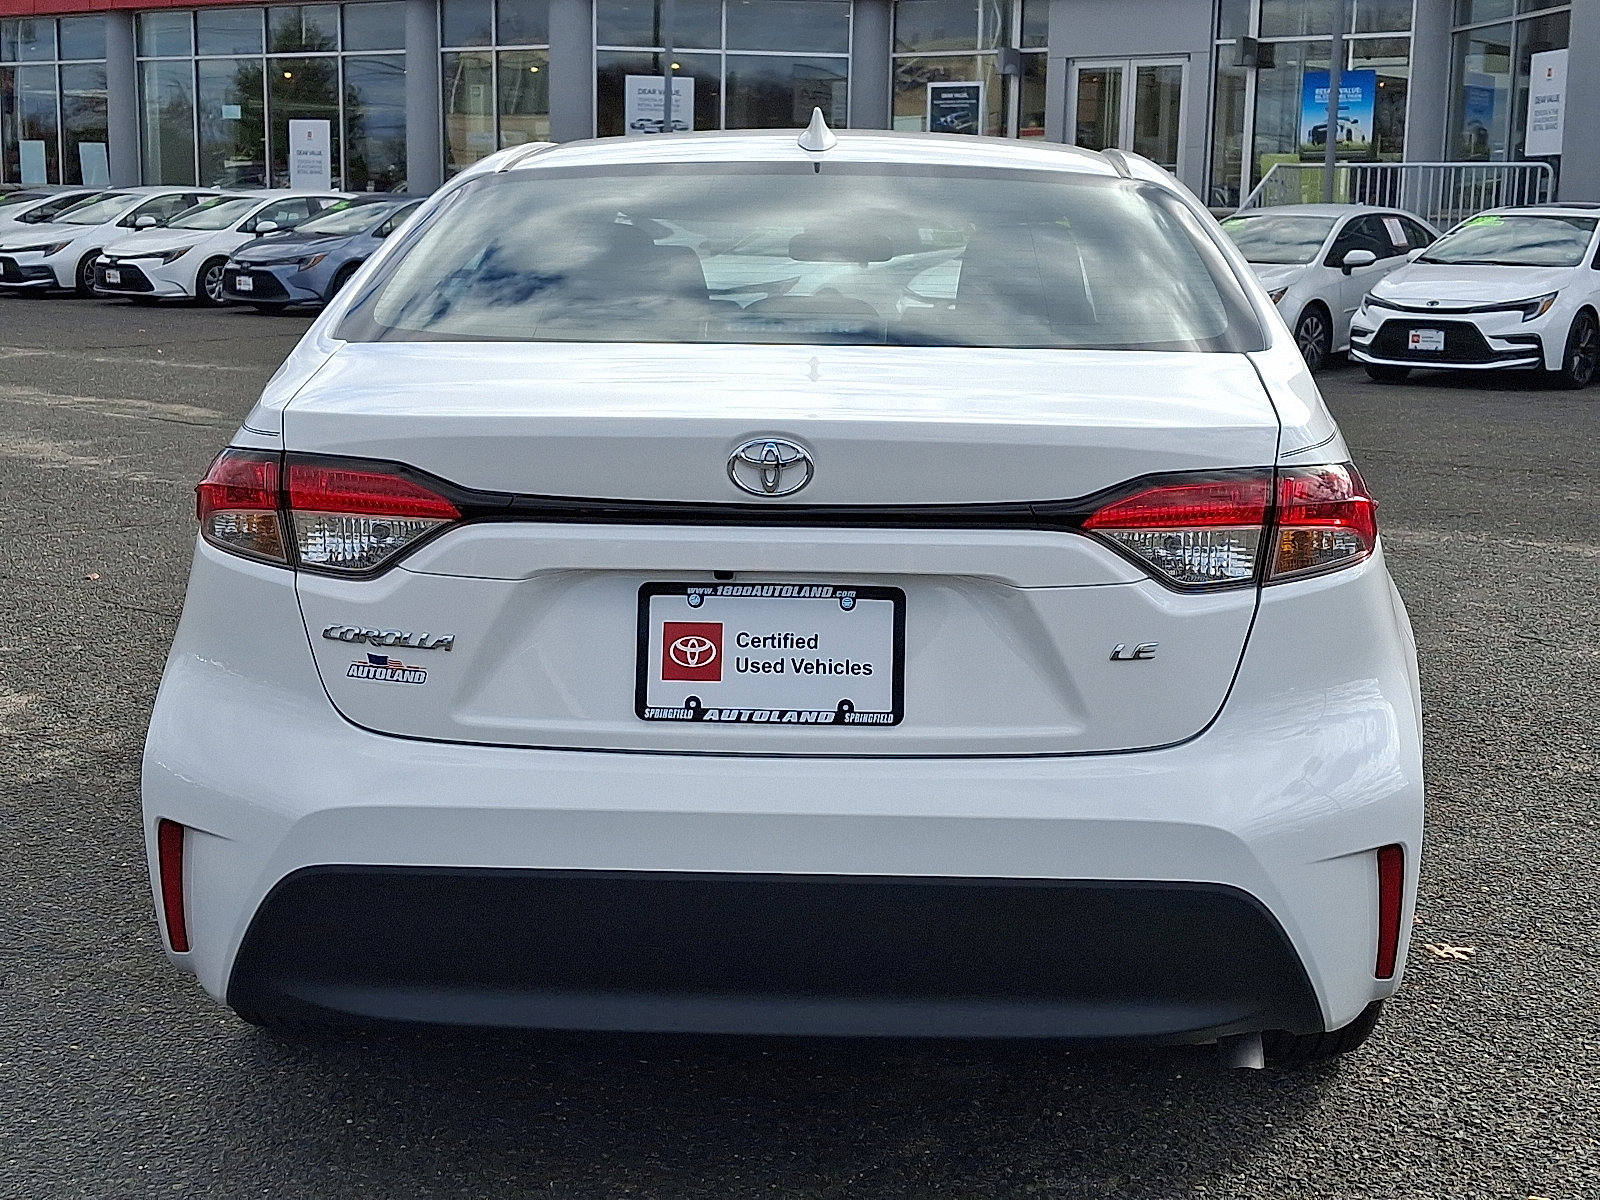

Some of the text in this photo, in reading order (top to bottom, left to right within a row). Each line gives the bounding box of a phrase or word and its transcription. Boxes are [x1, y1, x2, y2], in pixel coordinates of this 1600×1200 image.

[687, 584, 857, 599] www.1800AUTOLAND.com
[322, 623, 456, 651] COROLLA
[736, 632, 819, 650] Certified
[1108, 641, 1160, 661] LE
[348, 665, 426, 683] AUTOLAND
[736, 657, 874, 676] Used Vehicles
[644, 708, 894, 724] SPRINGFIELD AUTOLAND SPRINGFIELD
